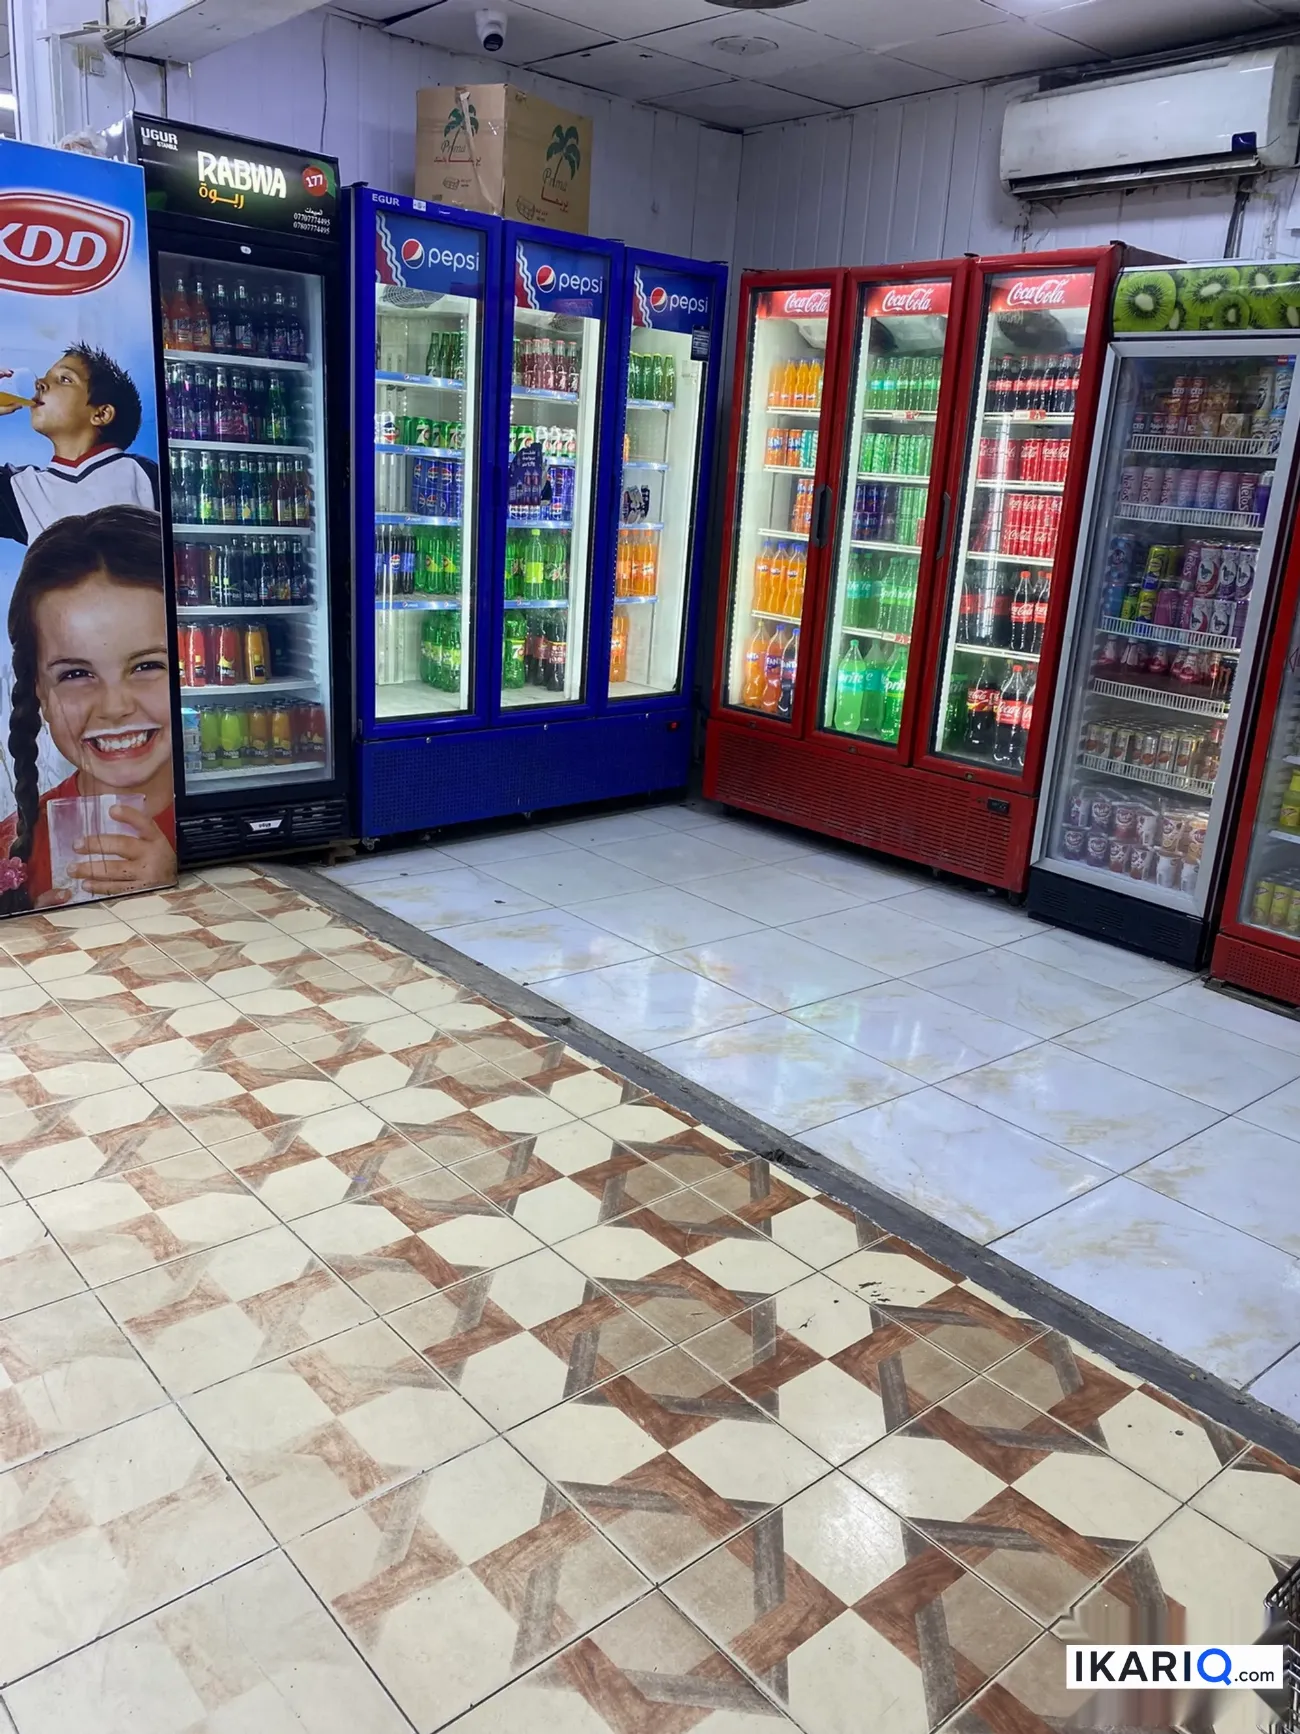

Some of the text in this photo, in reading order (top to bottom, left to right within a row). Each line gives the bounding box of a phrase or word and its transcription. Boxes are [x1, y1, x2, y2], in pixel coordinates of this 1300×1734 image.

[140, 126, 178, 145] UGUR
[197, 150, 287, 199] RABWA
[305, 174, 324, 188] 177
[372, 193, 400, 207] EGUR
[428, 247, 480, 273] pepsi
[558, 272, 604, 296] pepsi
[1006, 279, 1071, 306] Coca-Cola
[669, 293, 709, 315] pepsi
[882, 287, 935, 312] Coca-Cola
